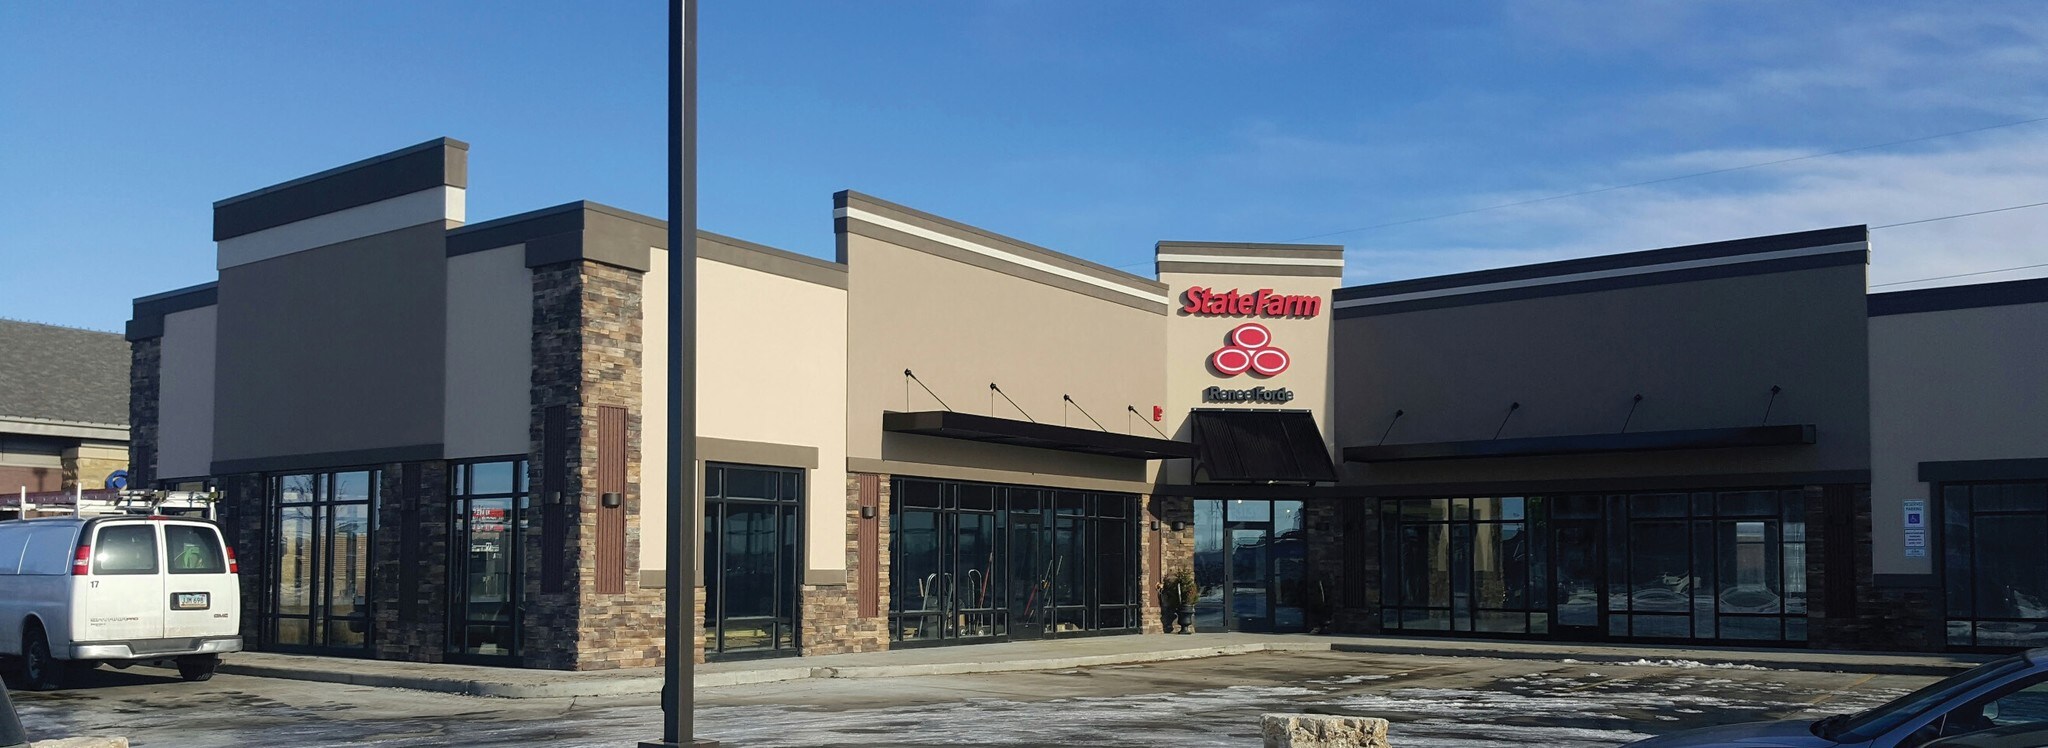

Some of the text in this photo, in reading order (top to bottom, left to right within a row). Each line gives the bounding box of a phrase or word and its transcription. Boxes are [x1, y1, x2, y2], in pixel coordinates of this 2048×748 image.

[1209, 386, 1294, 401] Renee Forde
[90, 580, 100, 589] 17
